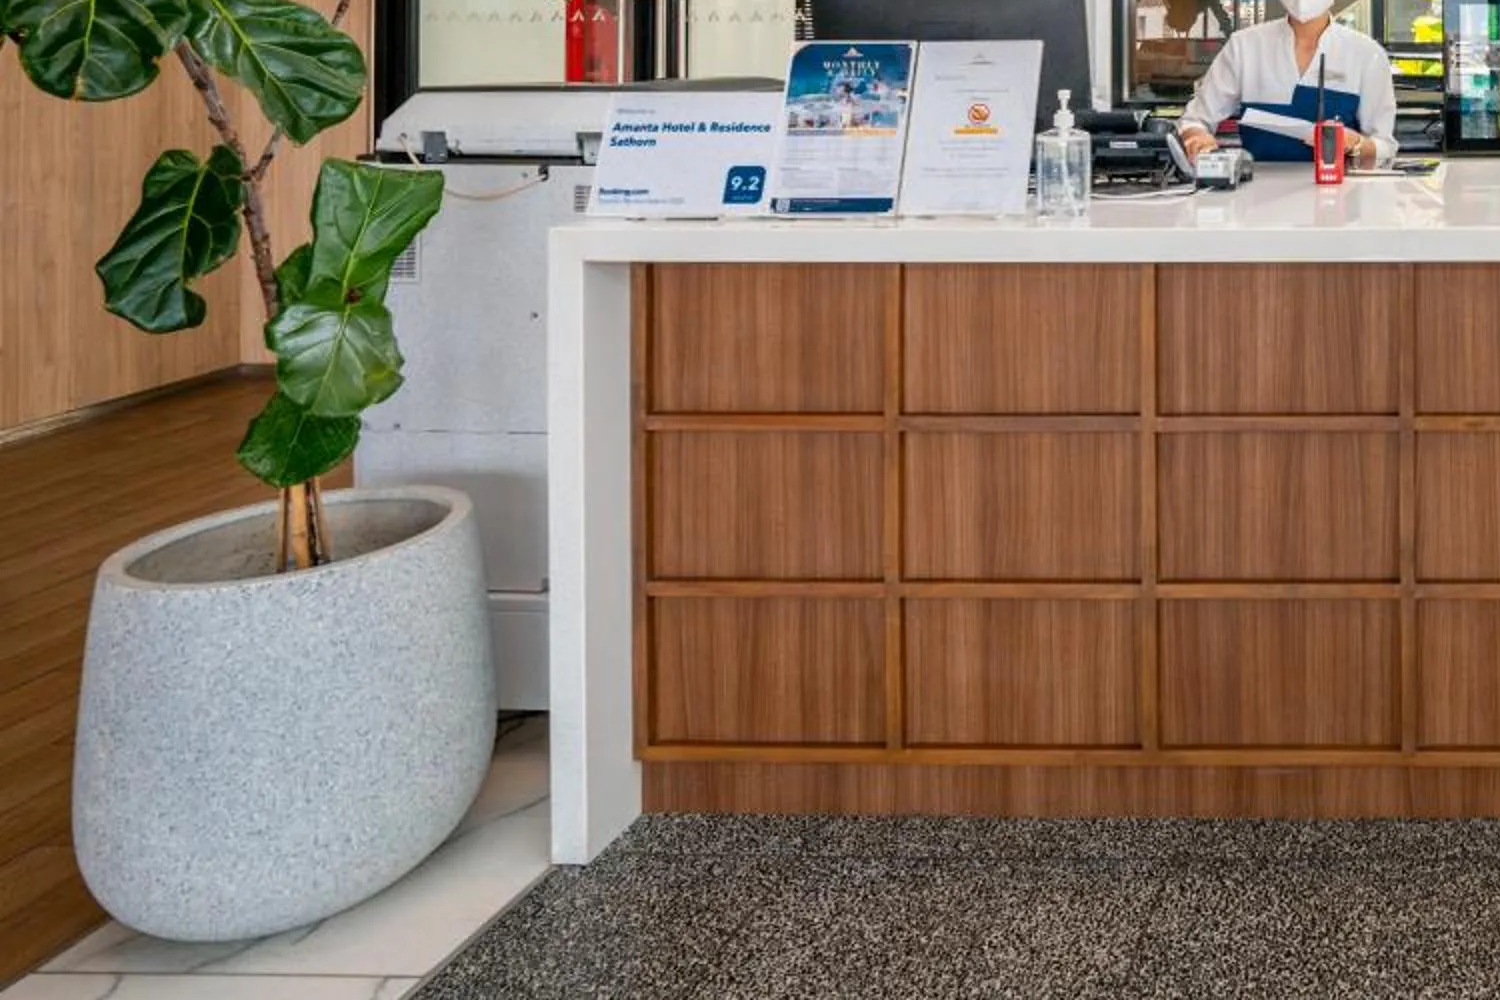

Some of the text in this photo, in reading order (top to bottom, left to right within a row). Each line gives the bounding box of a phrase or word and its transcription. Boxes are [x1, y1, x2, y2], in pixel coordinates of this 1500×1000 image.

[611, 121, 771, 133] Amanta Hotel & Residence
[609, 136, 657, 147] Sathorn
[731, 176, 760, 191] 9.2
